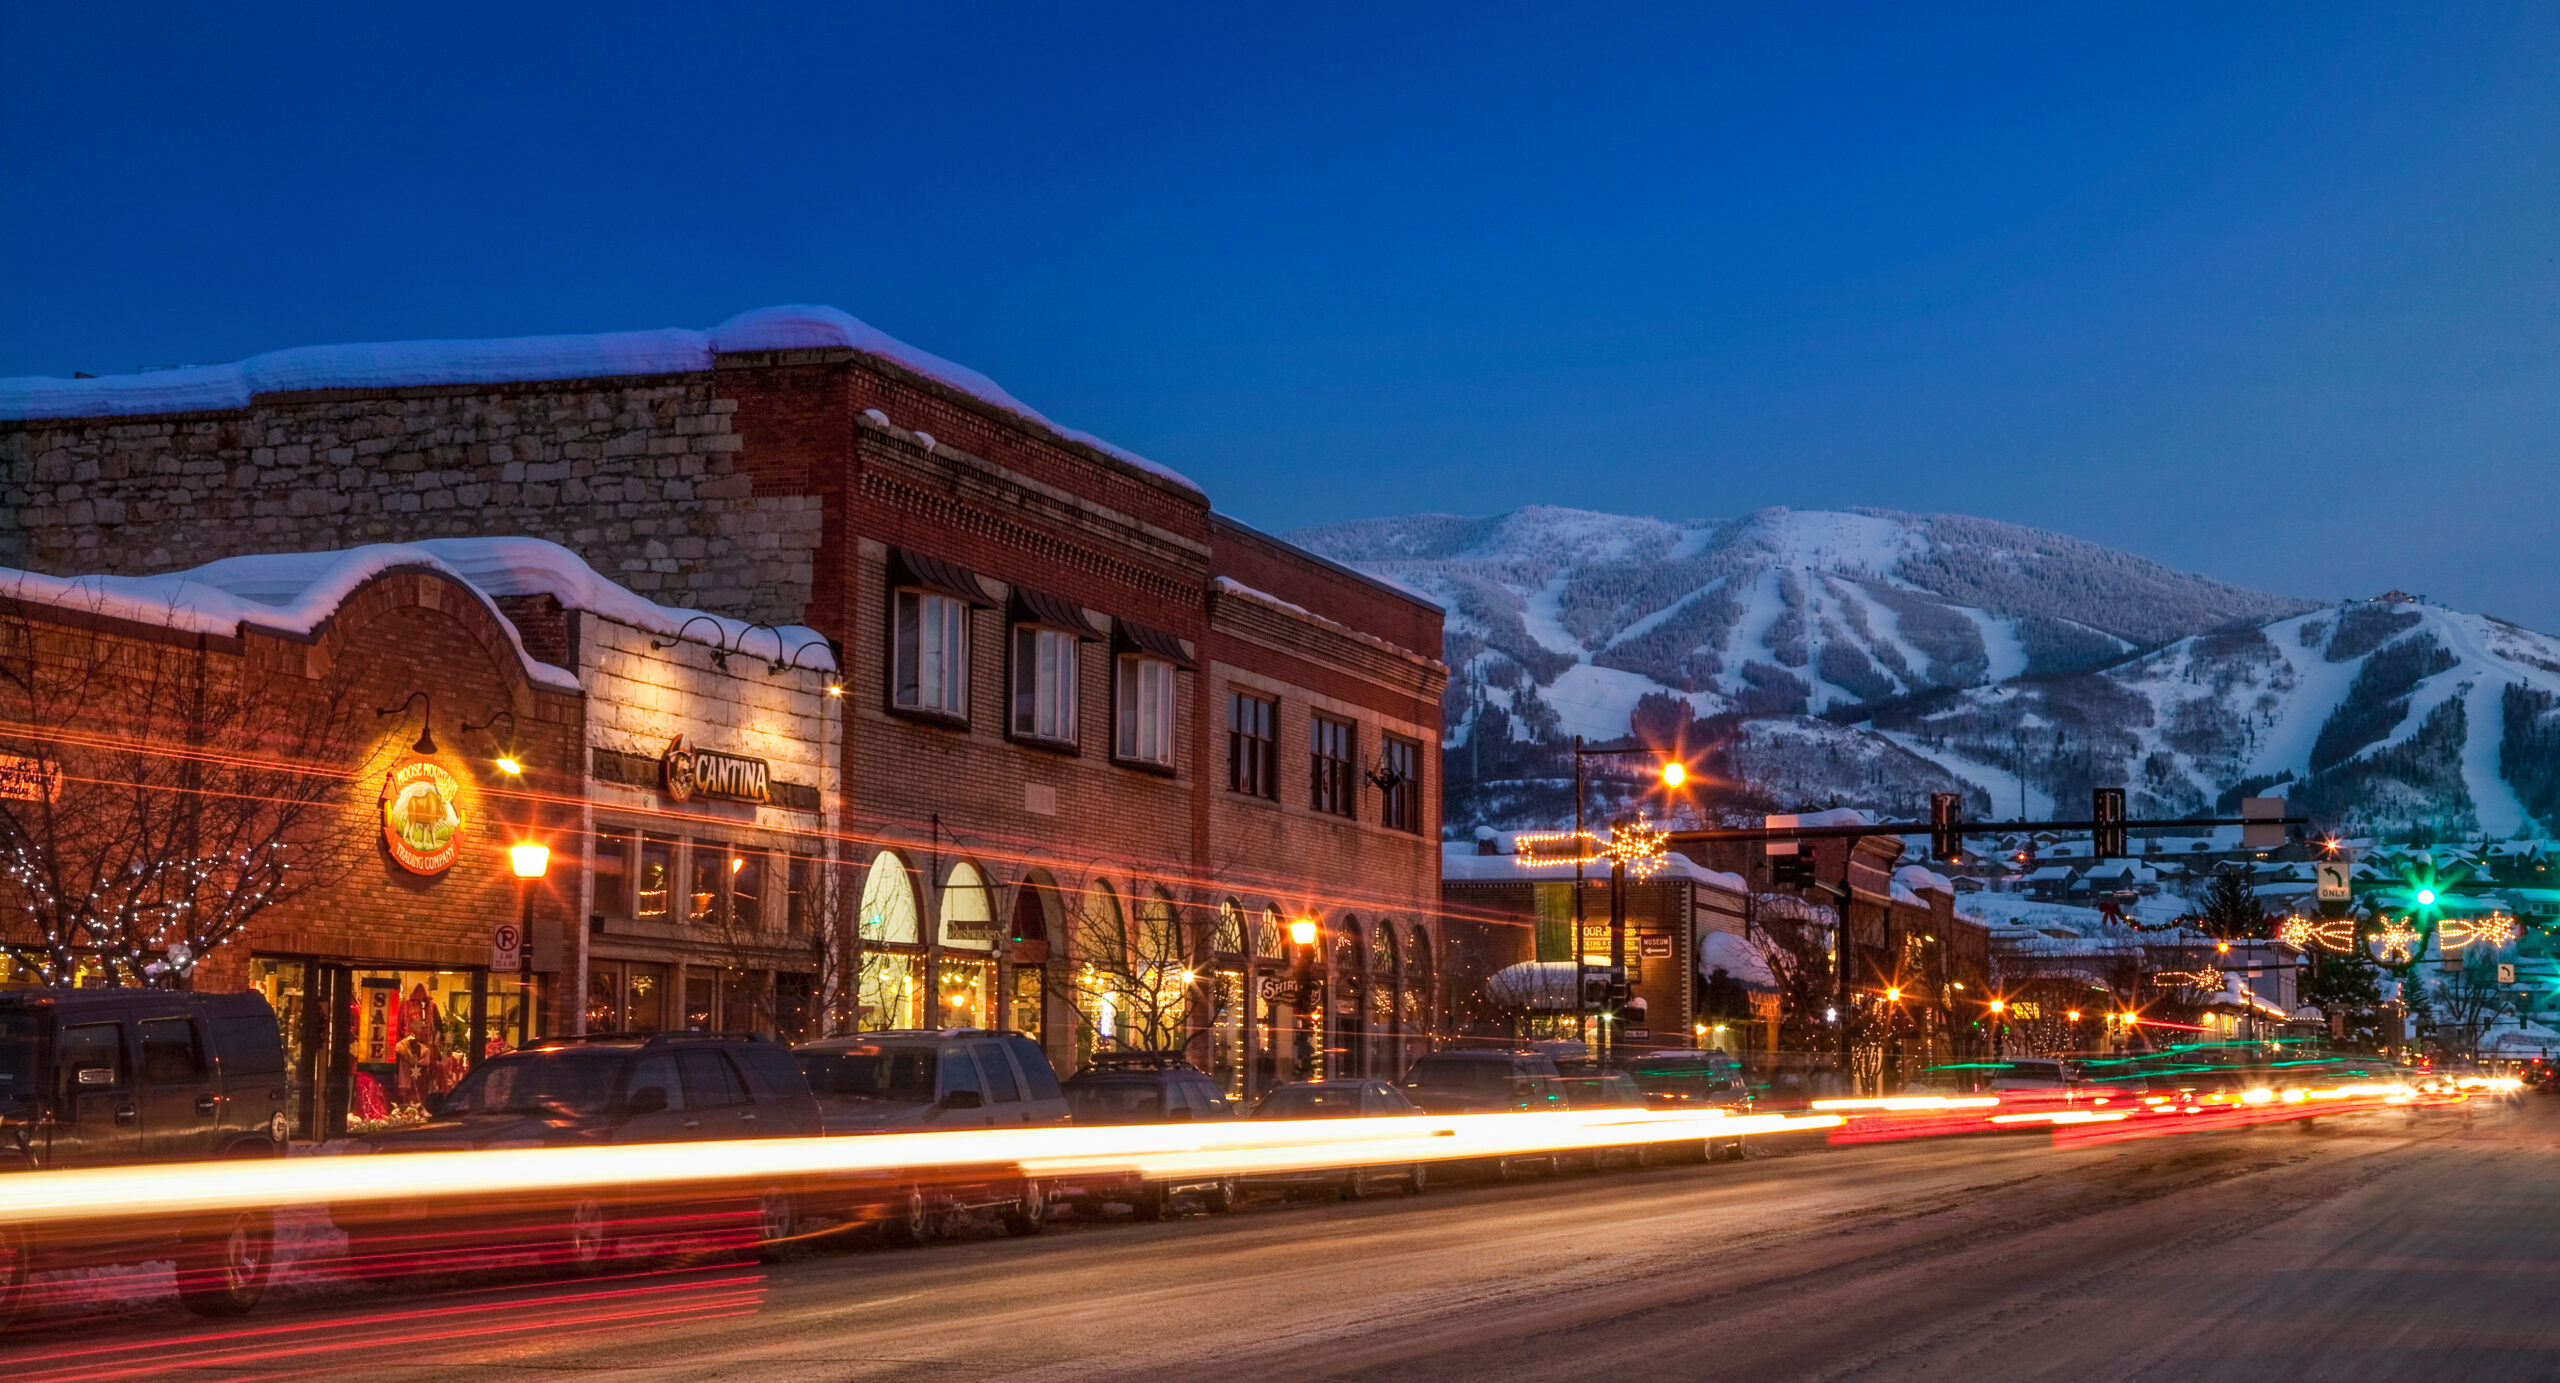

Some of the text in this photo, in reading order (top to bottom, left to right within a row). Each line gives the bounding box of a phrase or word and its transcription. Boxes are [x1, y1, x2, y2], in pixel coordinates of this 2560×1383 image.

[397, 763, 422, 785] MOOSE
[696, 755, 770, 802] CANTINA
[396, 843, 455, 870] TRADING COMPANY
[2322, 889, 2346, 897] ONLY
[952, 925, 1001, 941] Bushwackers
[1643, 938, 1669, 946] MUSEUM
[370, 992, 387, 1058] SALE
